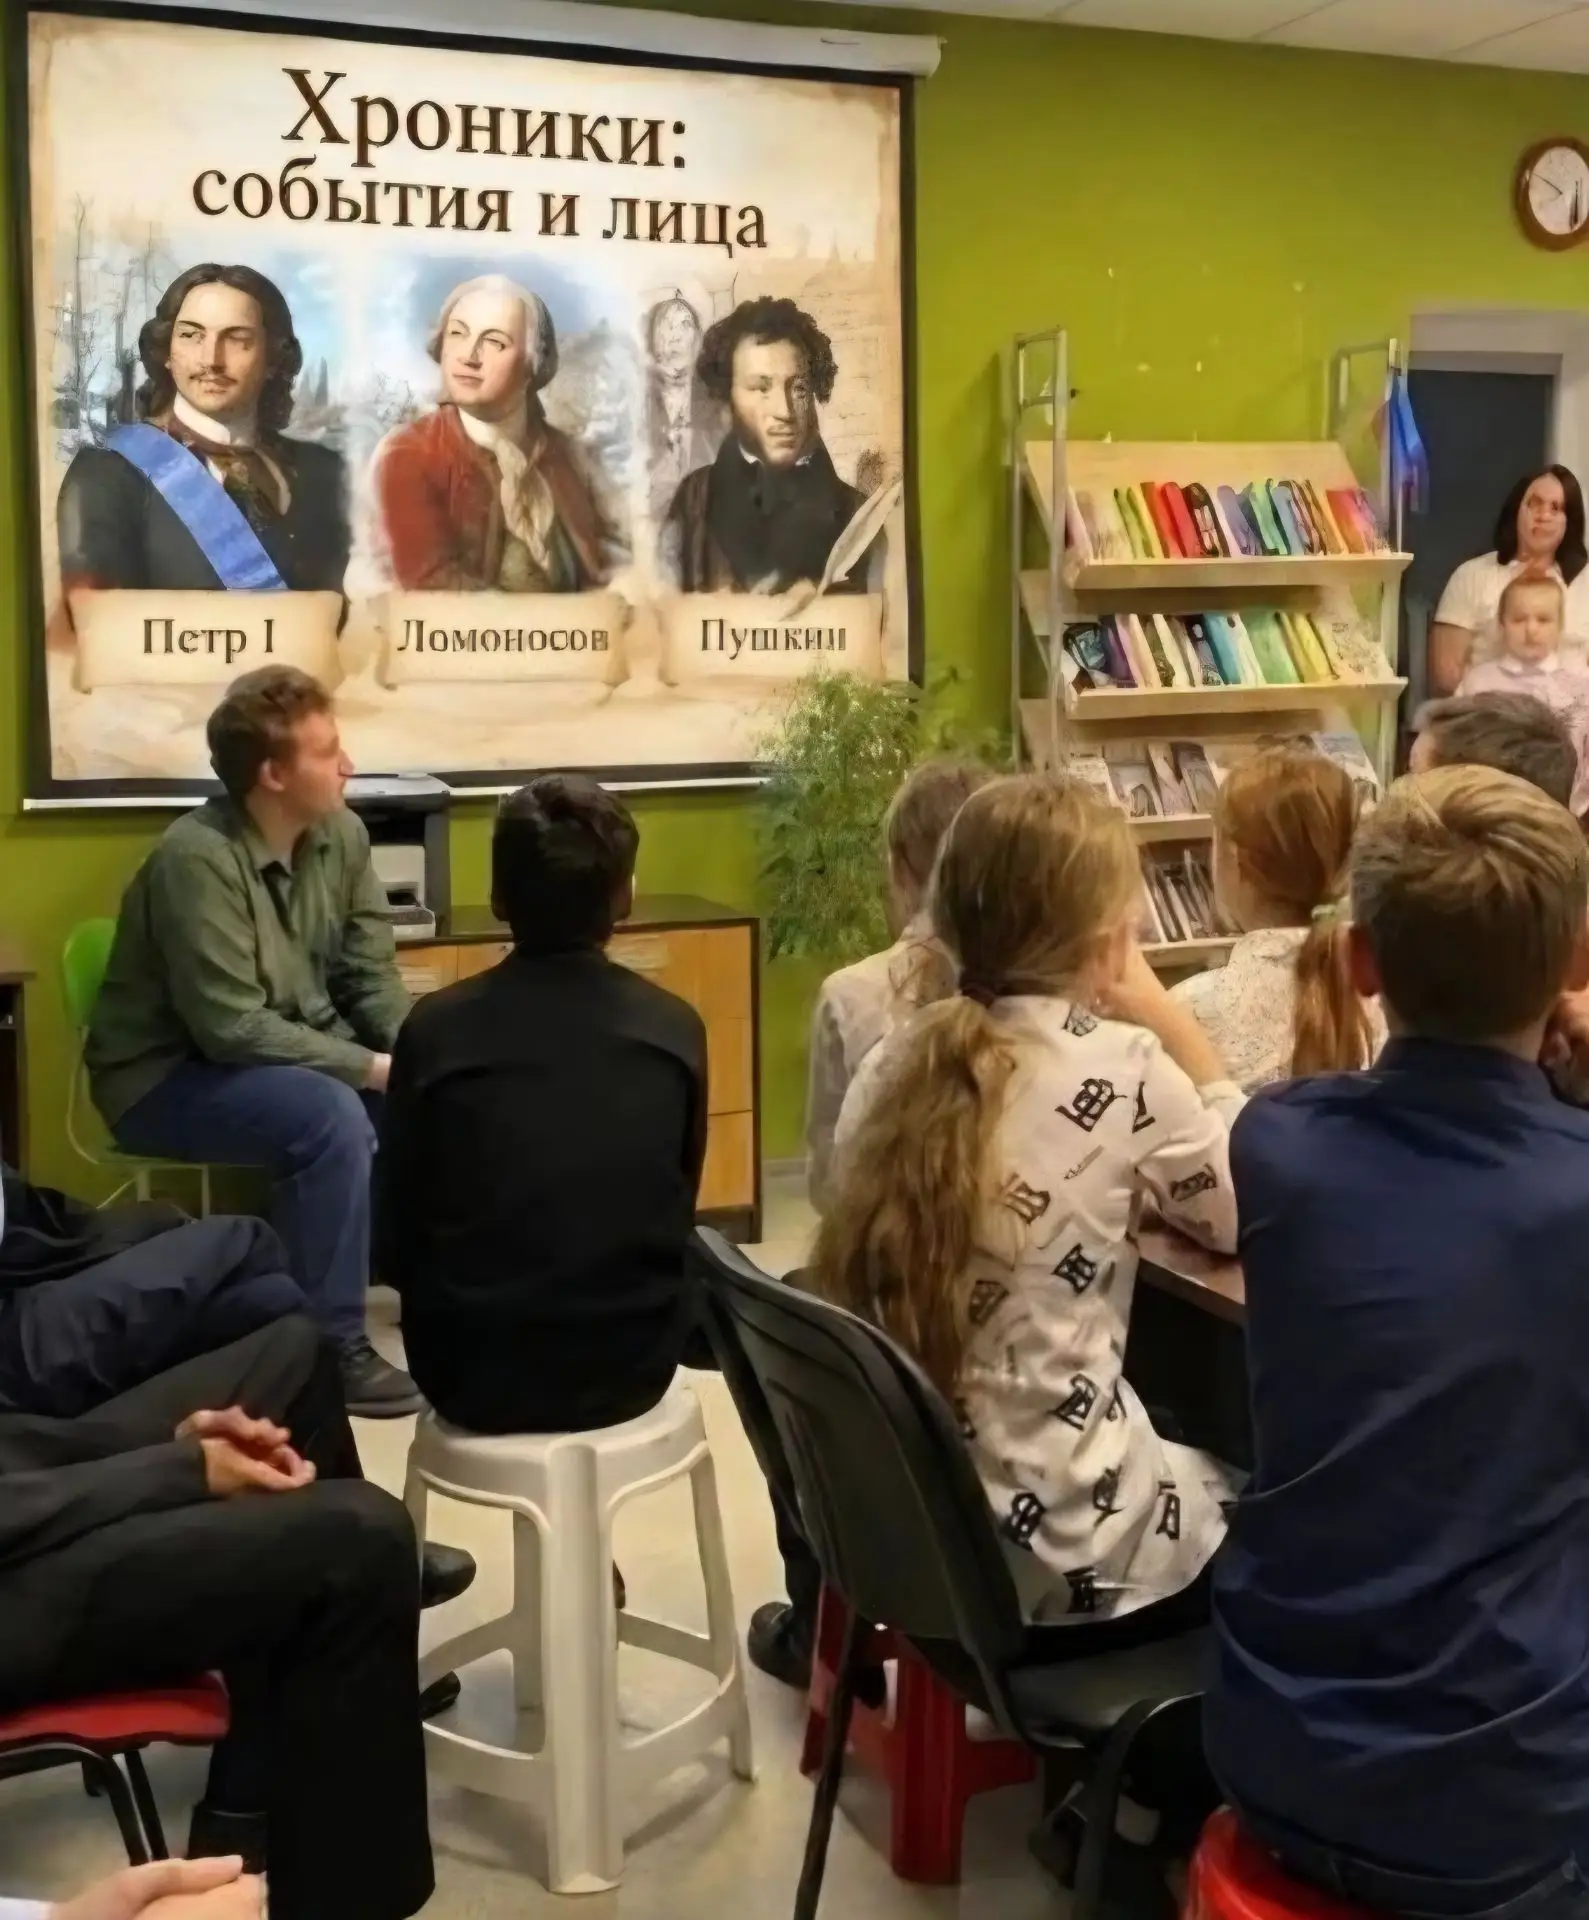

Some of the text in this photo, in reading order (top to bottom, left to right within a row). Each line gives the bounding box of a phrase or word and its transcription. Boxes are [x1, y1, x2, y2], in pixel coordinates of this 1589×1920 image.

[280, 68, 687, 169] Хроники:
[192, 154, 768, 259] события и лица
[396, 619, 609, 652] Ломоносов
